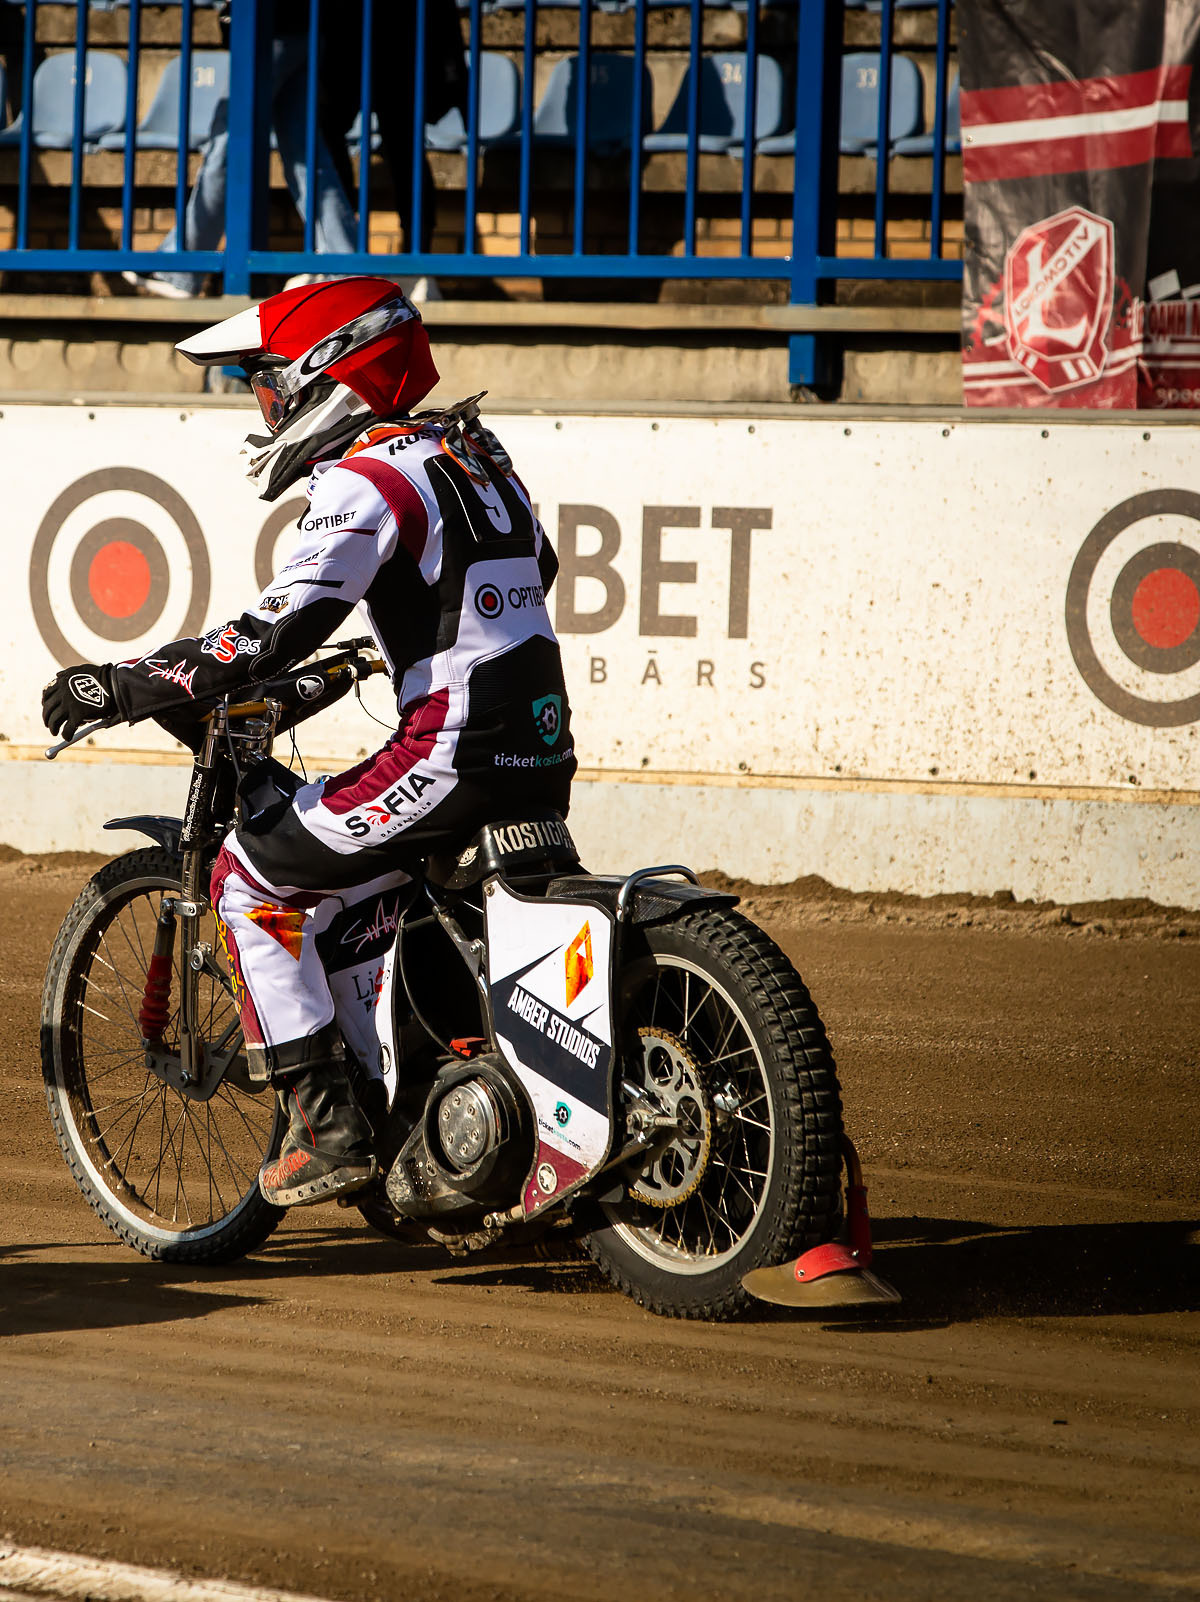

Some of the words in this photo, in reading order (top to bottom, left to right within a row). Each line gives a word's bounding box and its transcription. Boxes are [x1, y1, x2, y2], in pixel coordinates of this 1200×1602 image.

[304, 510, 357, 532] OPTIBET
[590, 650, 767, 689] BĀRS
[507, 985, 550, 1034] AMBER
[546, 1013, 601, 1070] STUDIOS
